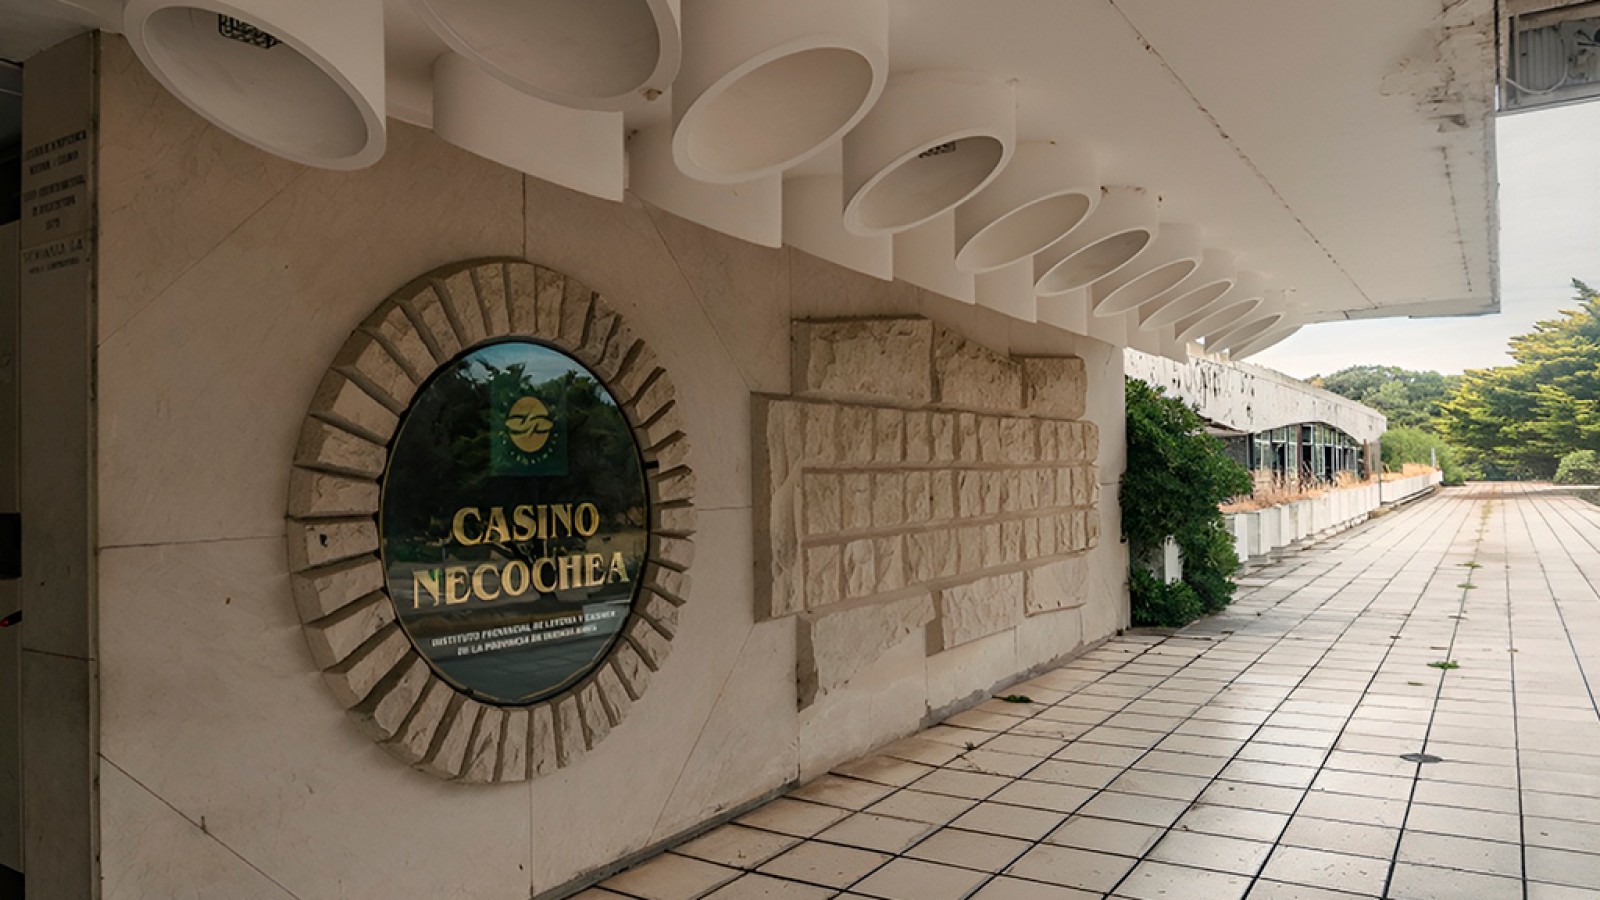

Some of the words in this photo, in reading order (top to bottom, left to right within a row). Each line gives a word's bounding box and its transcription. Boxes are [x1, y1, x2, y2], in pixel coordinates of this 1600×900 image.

[452, 502, 600, 546] CASINO
[412, 551, 630, 609] NECOCHEA
[471, 643, 485, 654] LA
